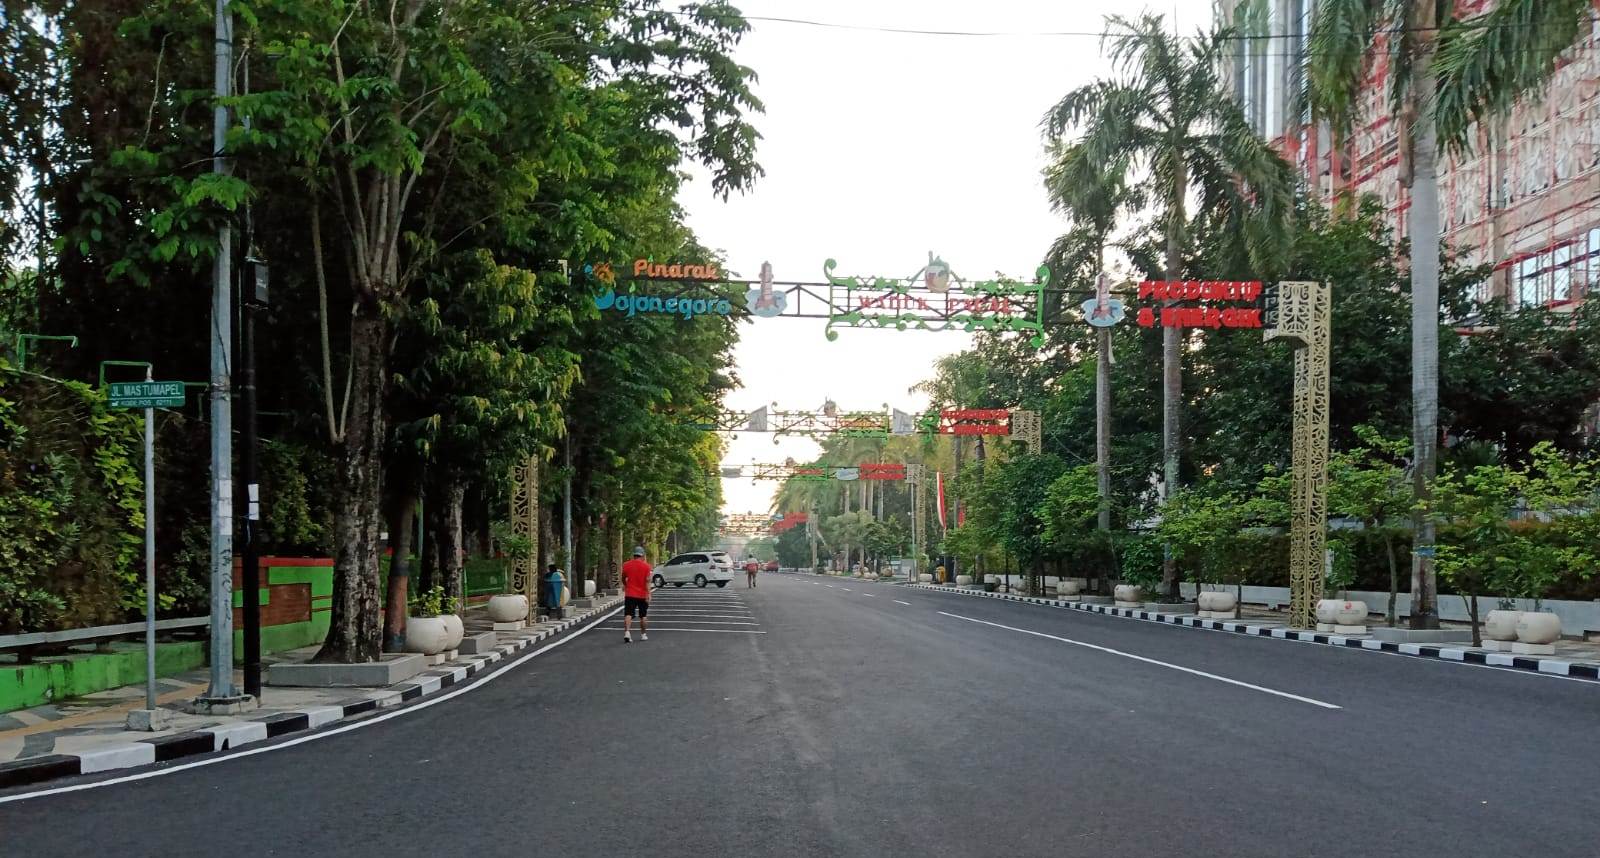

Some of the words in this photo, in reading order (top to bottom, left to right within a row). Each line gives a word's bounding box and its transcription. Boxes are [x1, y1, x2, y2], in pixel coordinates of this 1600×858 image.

[633, 257, 720, 280] Pinarak
[124, 385, 141, 396] MAS
[142, 384, 181, 396] TUMAPEL
